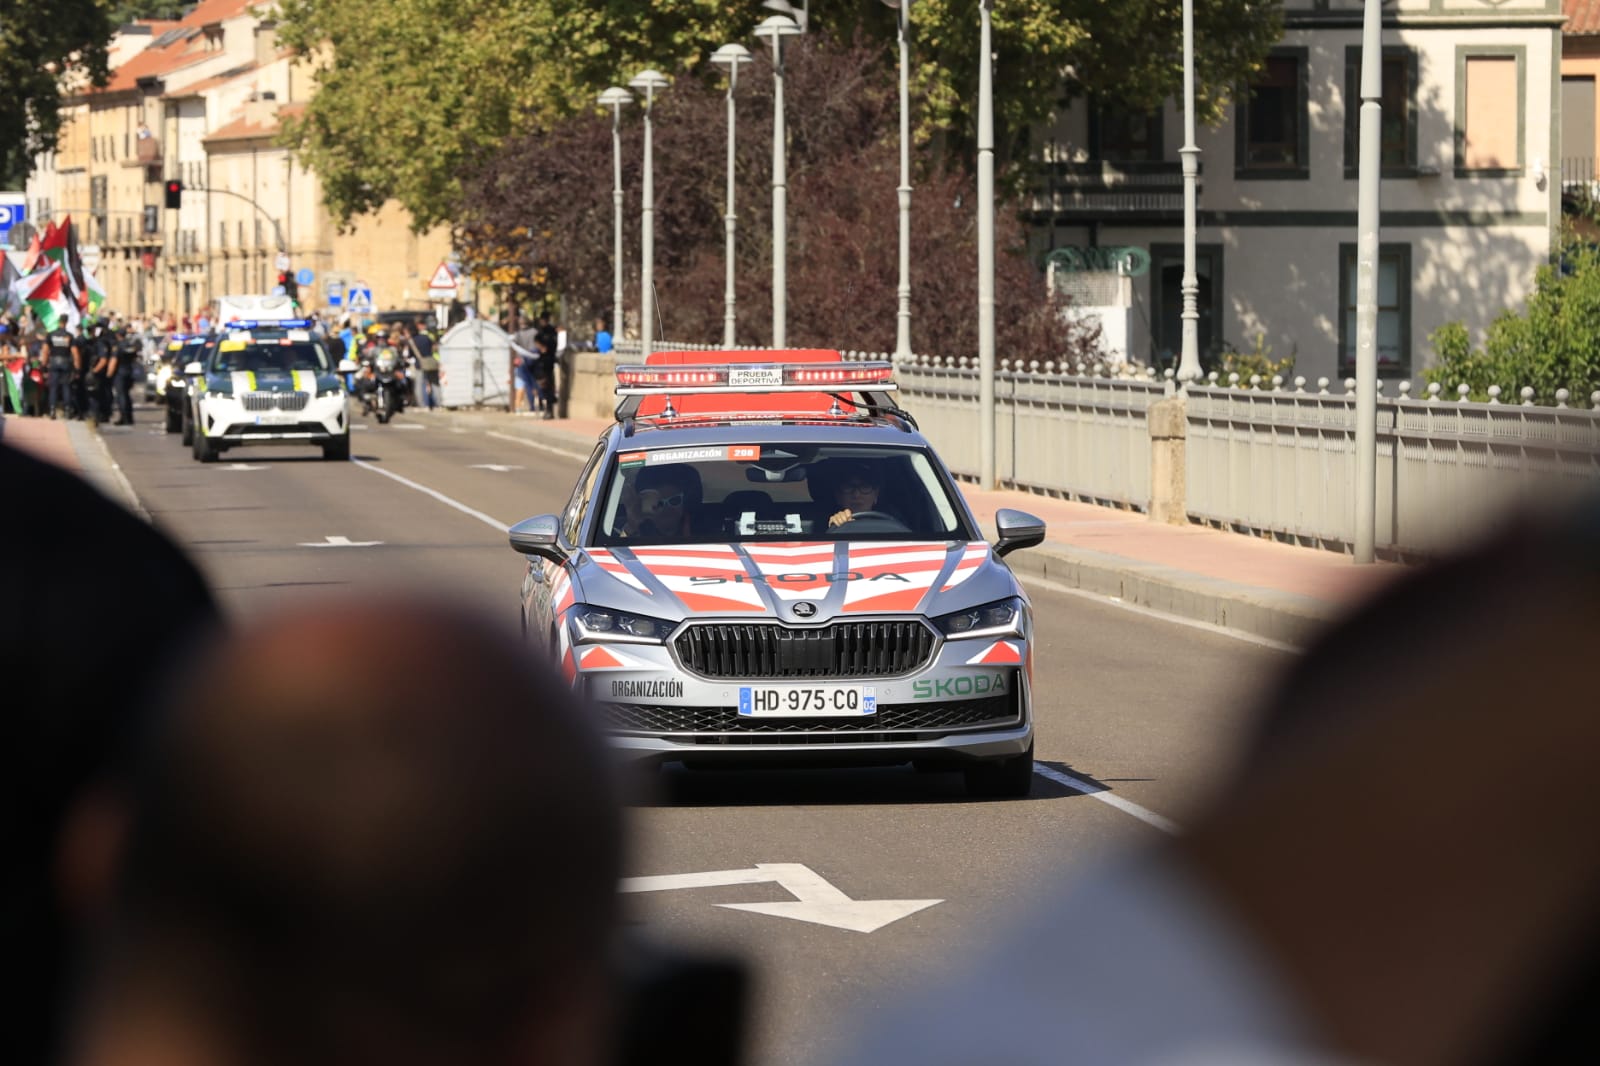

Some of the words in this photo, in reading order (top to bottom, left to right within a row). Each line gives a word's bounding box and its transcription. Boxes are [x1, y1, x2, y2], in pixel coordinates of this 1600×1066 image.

[731, 377, 780, 385] DEPORTIVA
[651, 449, 722, 462] ORGANIZACIÓN
[689, 571, 911, 586] SKODA
[611, 677, 684, 698] ORGANIZACIÓN
[912, 673, 1005, 699] SKODA
[864, 700, 876, 711] 02
